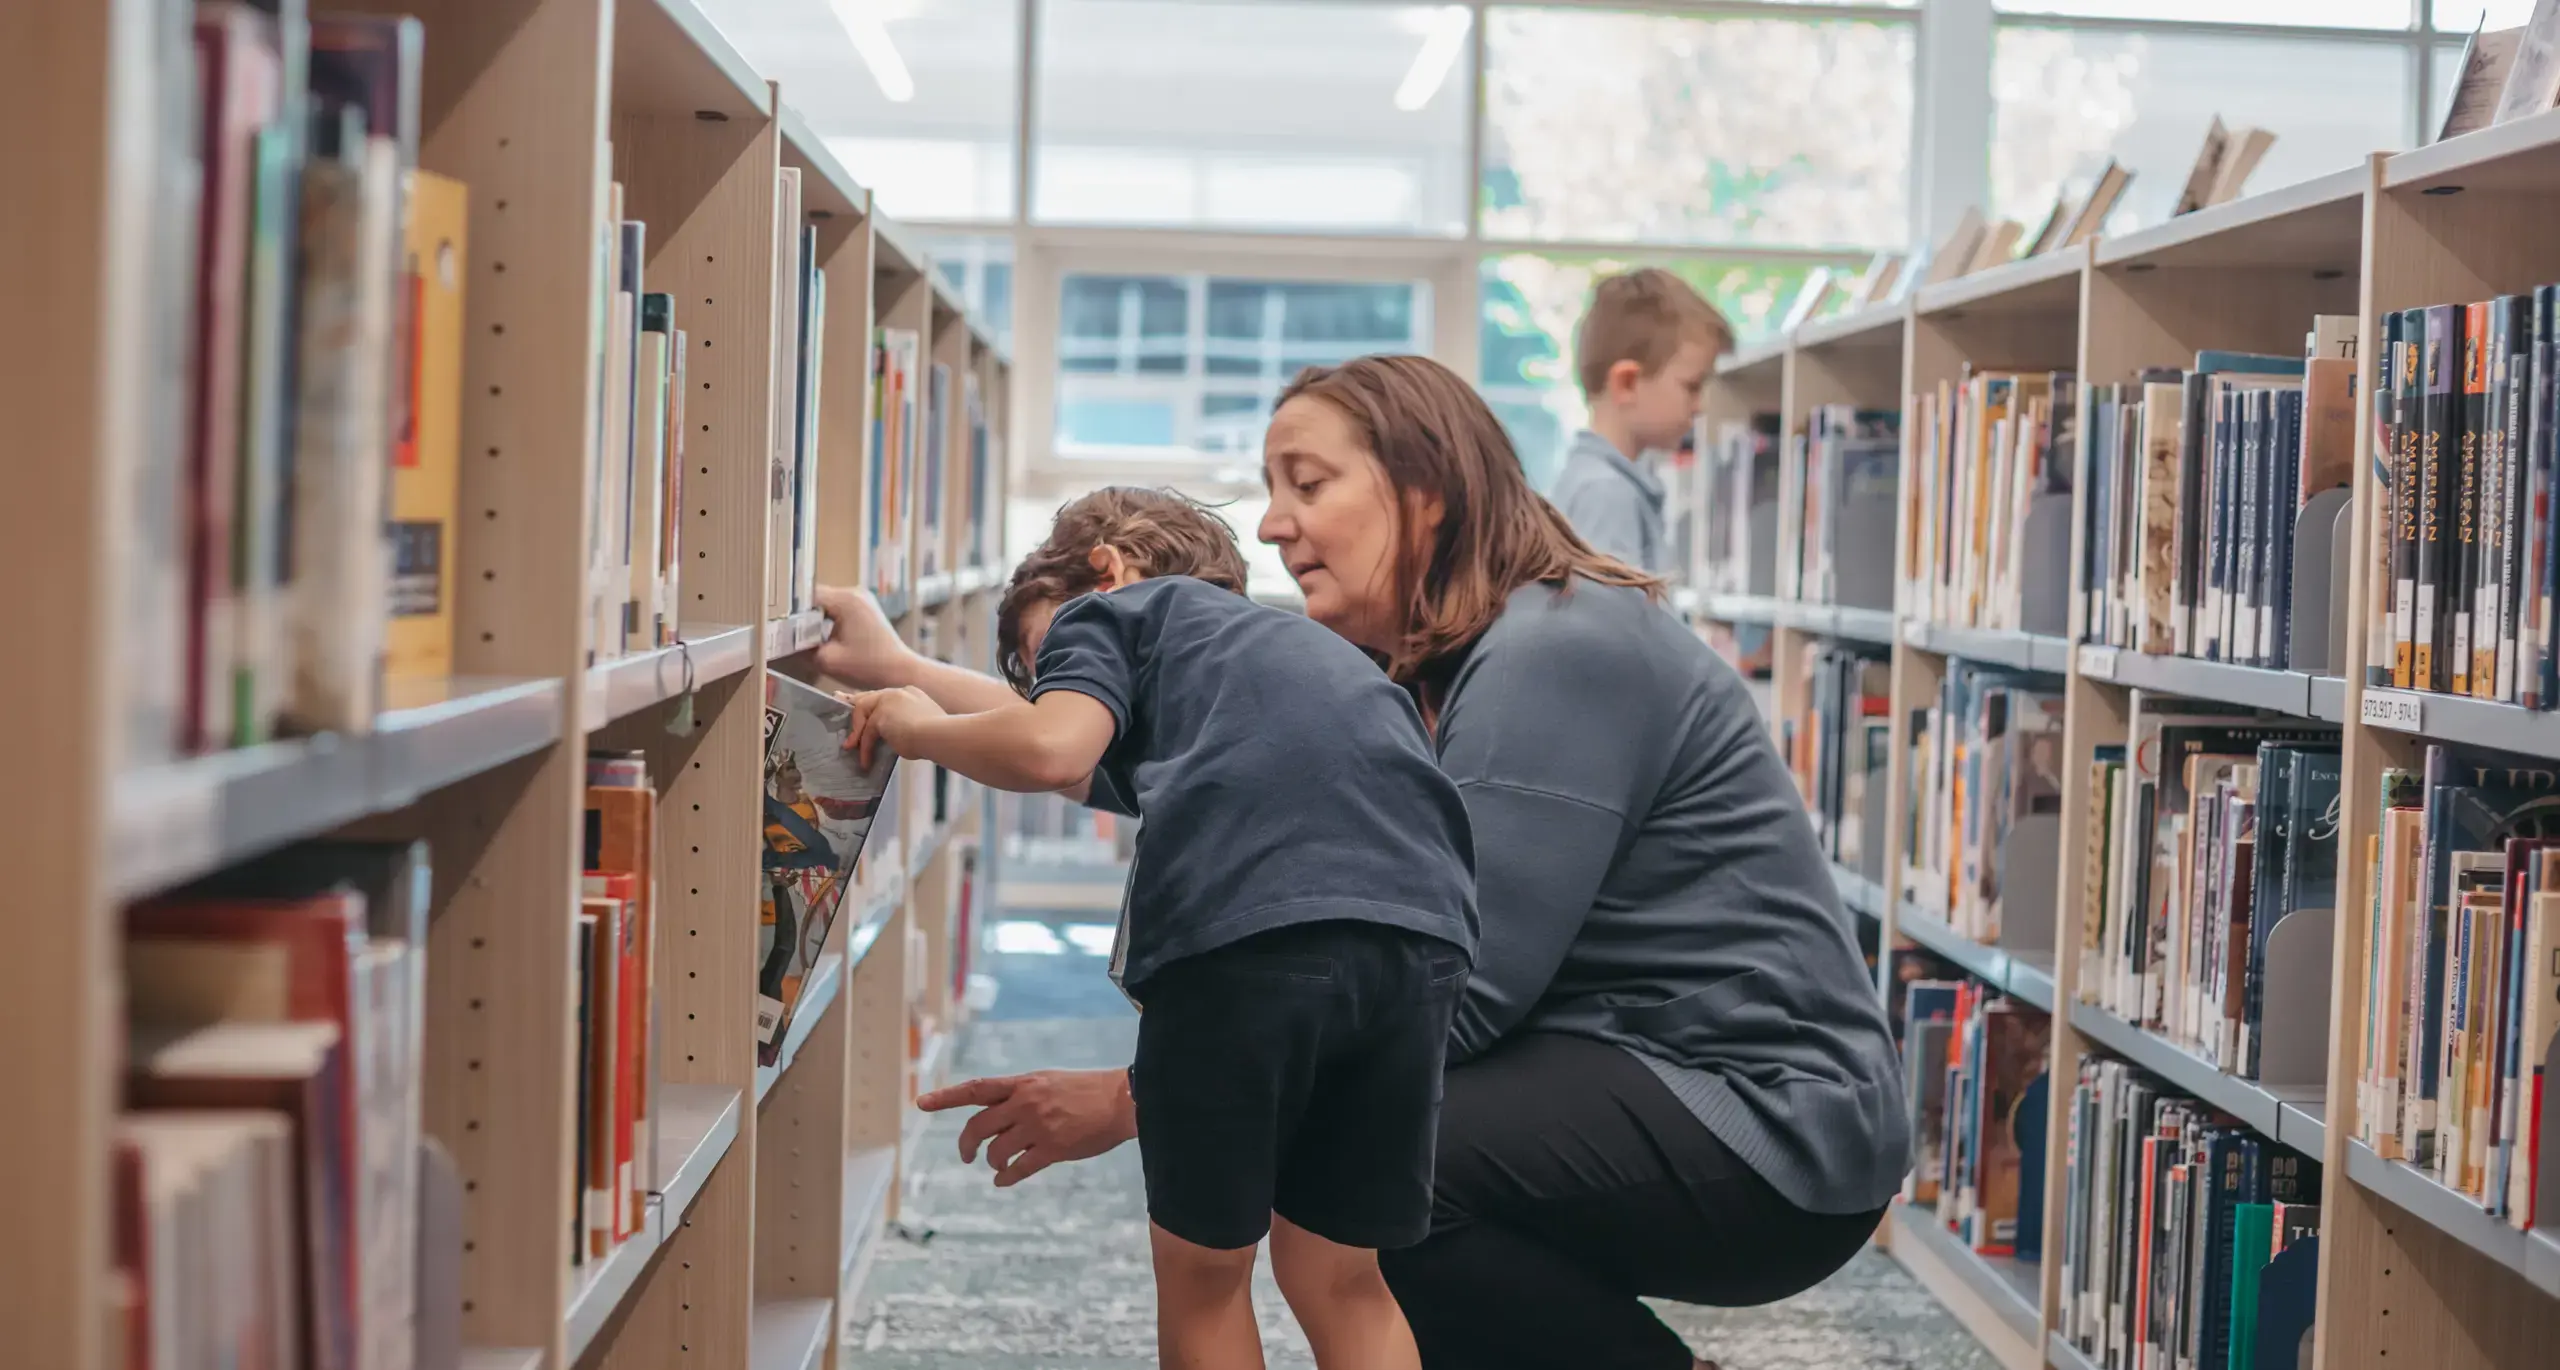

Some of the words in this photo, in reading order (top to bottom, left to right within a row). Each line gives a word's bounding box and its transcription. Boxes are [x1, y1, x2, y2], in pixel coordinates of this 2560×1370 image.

[2509, 392, 2518, 440] WATERGATE
[2406, 430, 2419, 540] AMERICAN
[2428, 430, 2440, 541] AMERICAN
[2463, 431, 2476, 543] AMERICAN
[2494, 430, 2505, 547] AMERICAN
[2364, 699, 2393, 719] 973.917
